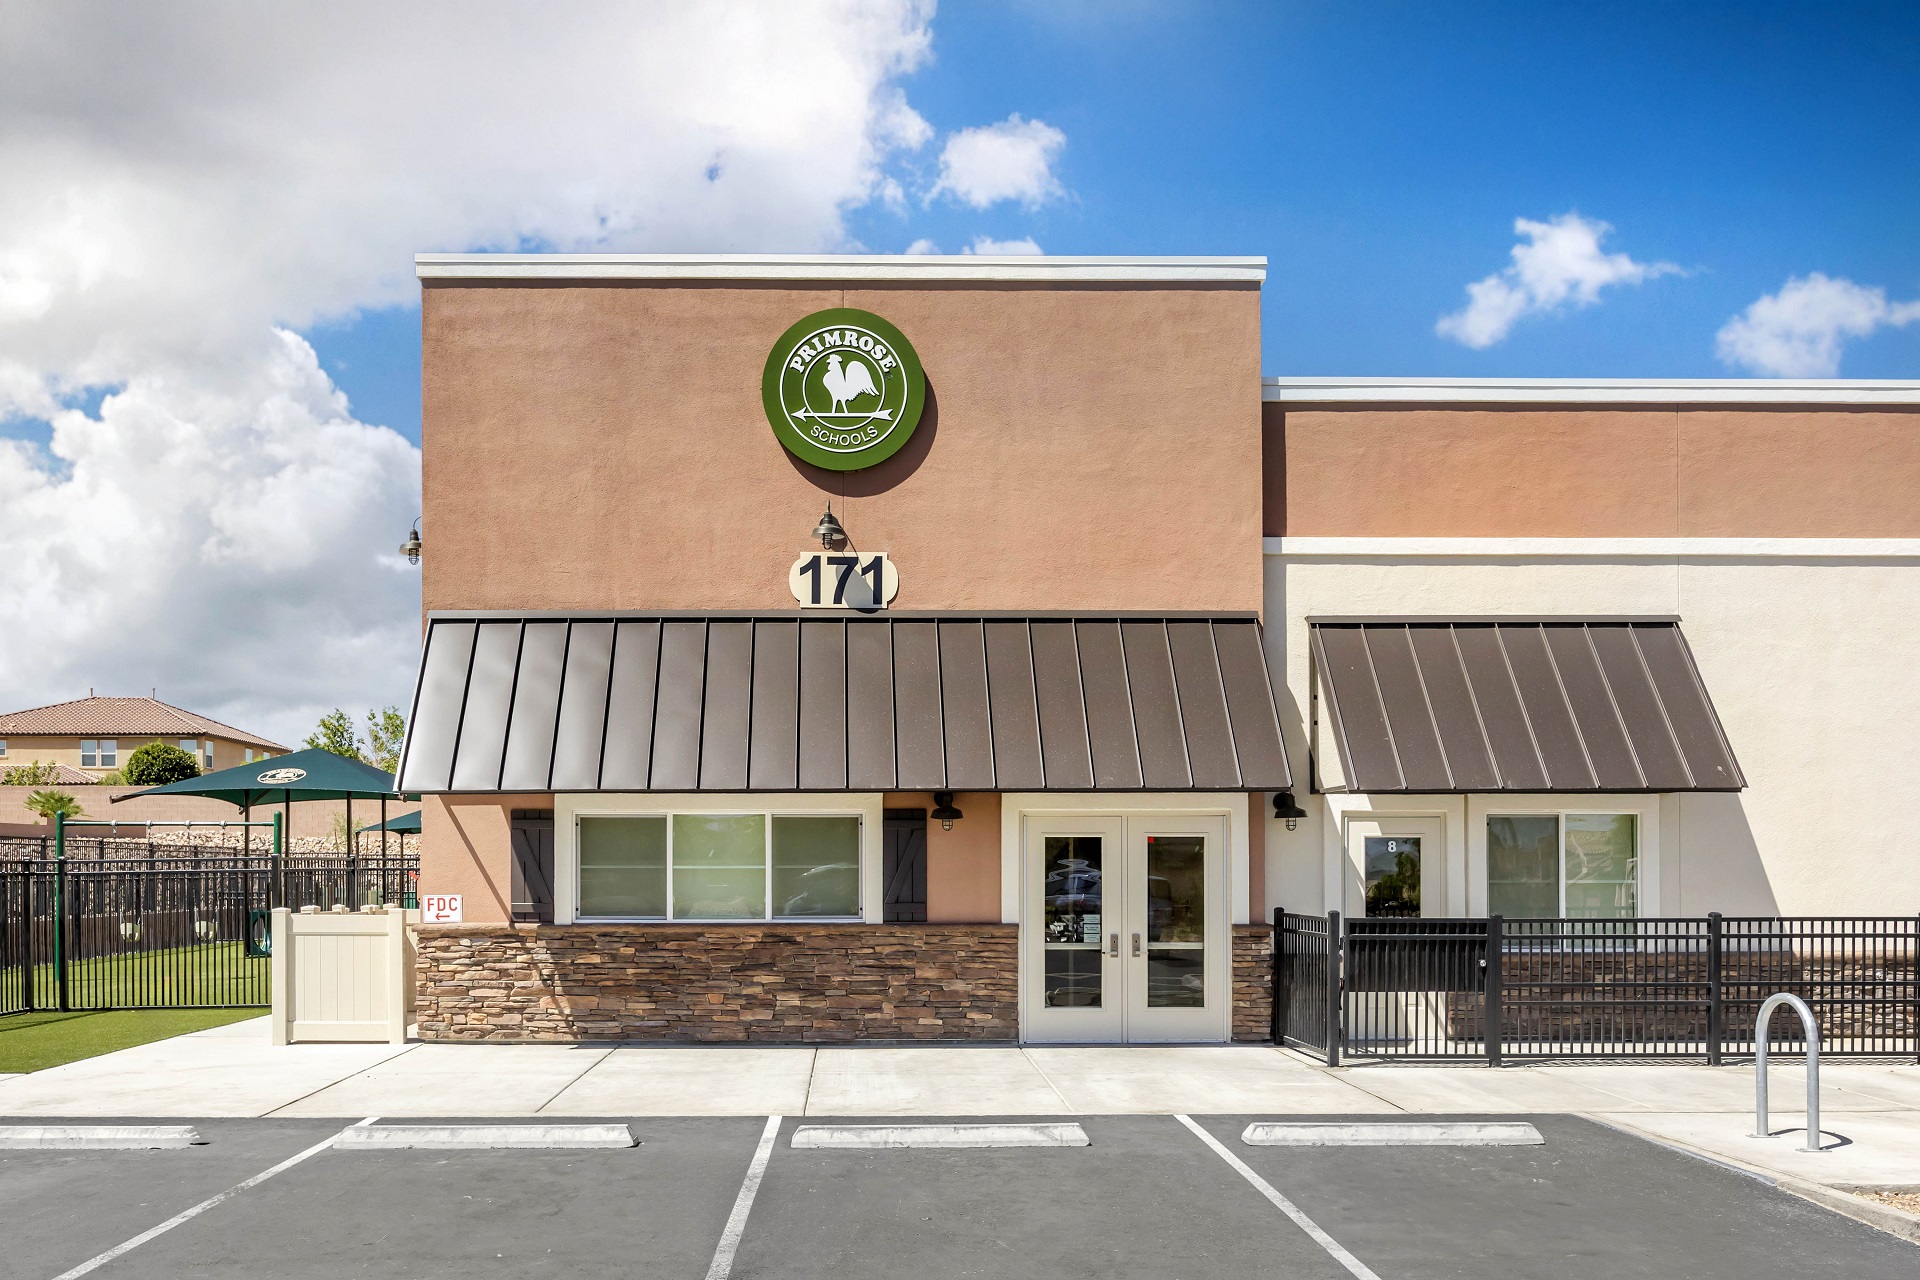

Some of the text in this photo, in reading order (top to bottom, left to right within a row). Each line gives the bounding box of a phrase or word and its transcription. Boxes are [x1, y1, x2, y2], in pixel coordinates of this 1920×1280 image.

[790, 330, 896, 373] PRIMROSE
[810, 425, 878, 446] SCHOOLS
[799, 555, 883, 605] 171
[1387, 840, 1397, 853] 8
[427, 897, 458, 911] FDC
